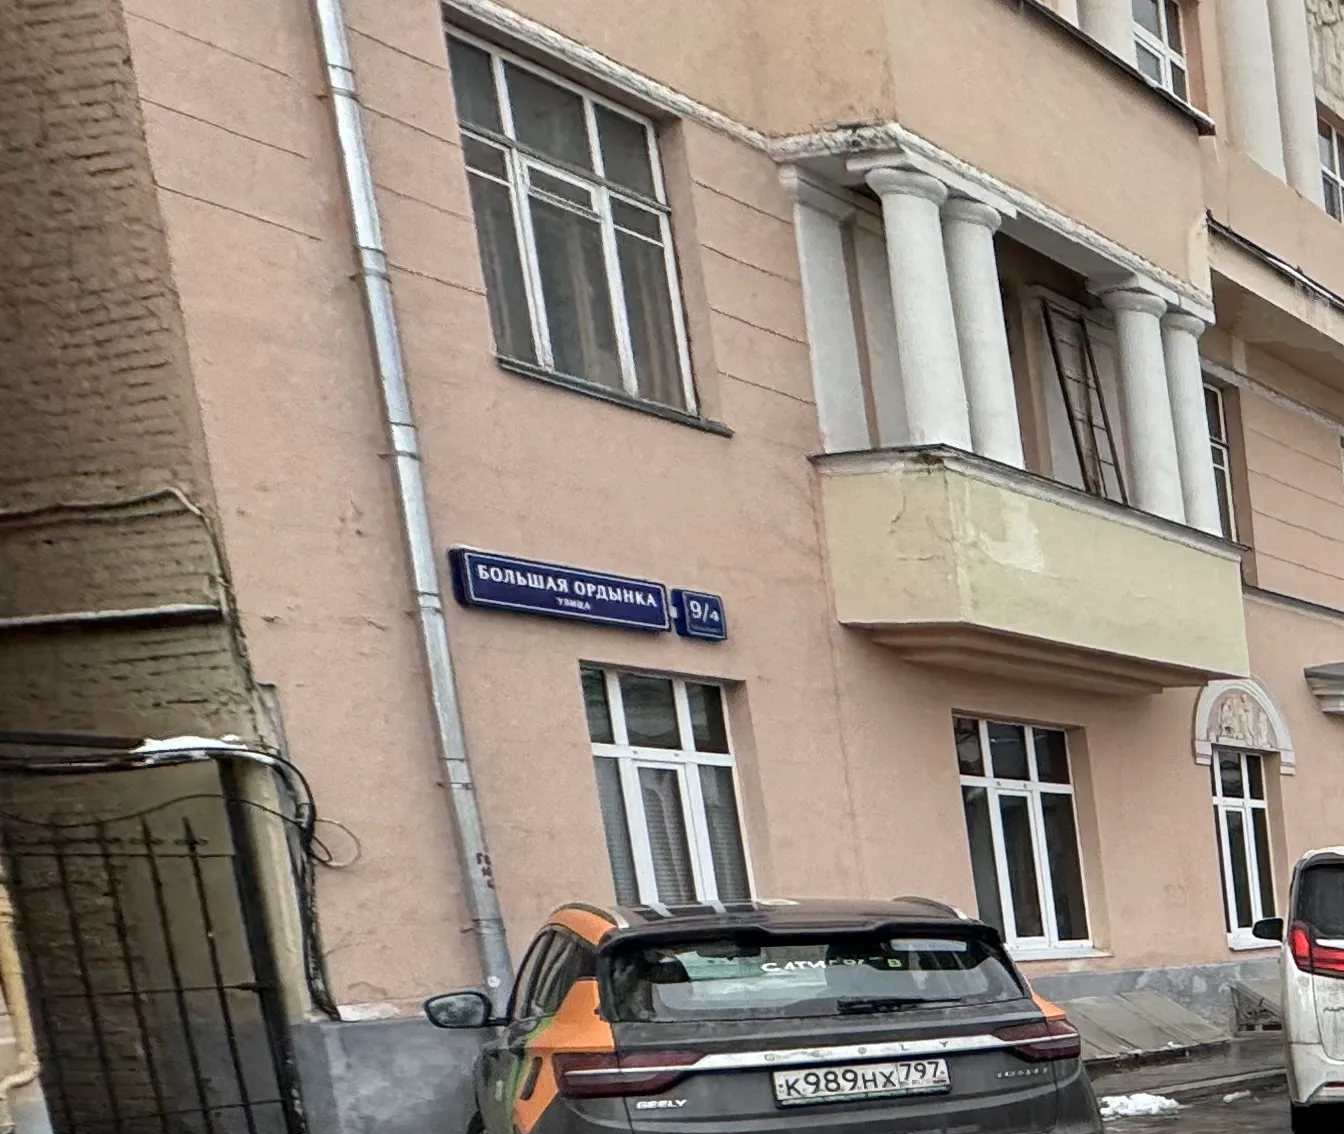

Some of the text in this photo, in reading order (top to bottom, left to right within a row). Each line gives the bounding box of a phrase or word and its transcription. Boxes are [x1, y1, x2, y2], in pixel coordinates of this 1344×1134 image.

[477, 564, 658, 608] БОЛЬШАЯ ОРДЫНКА
[690, 600, 720, 622] 9/4
